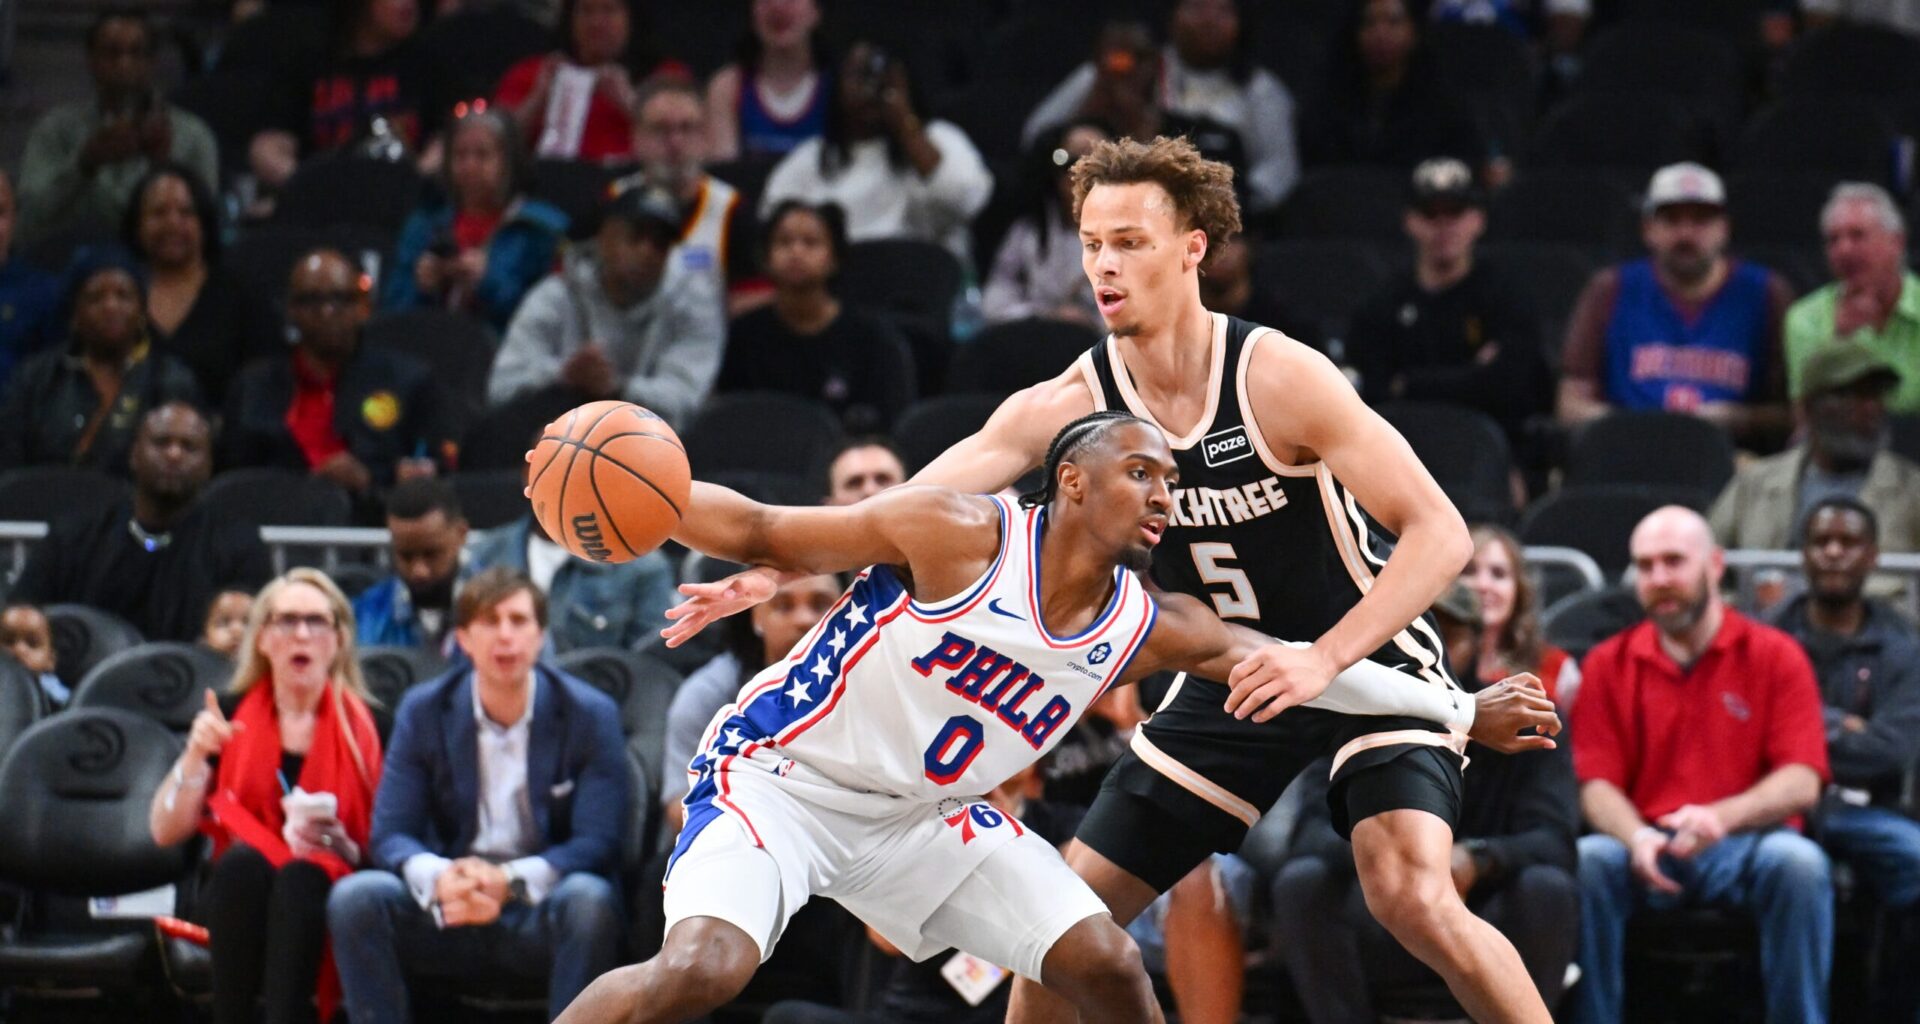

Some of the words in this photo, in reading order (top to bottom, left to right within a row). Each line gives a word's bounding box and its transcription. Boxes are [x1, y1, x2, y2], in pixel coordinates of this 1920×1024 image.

[1207, 435, 1247, 458] paze
[1168, 476, 1289, 527] CHTREE
[572, 512, 613, 561] Wil
[1189, 542, 1260, 620] 5
[911, 631, 1071, 751] PHILA
[1066, 661, 1103, 681] crypto.com
[924, 715, 985, 786] 0
[943, 804, 1003, 845] 76
